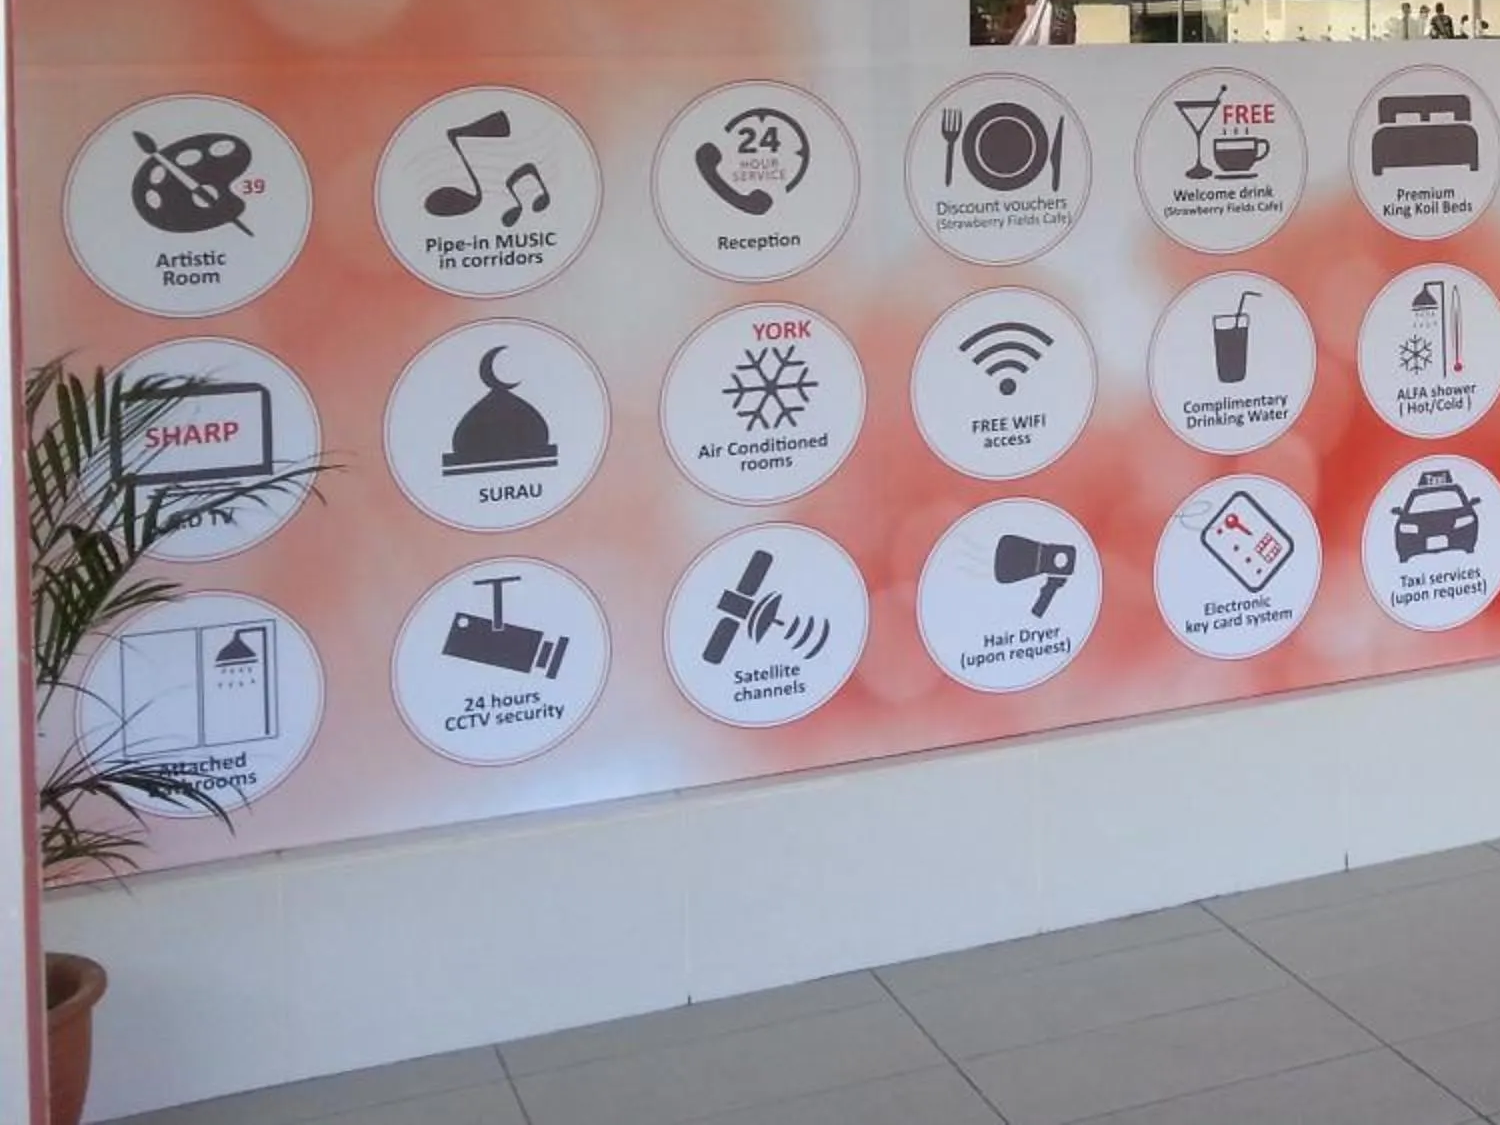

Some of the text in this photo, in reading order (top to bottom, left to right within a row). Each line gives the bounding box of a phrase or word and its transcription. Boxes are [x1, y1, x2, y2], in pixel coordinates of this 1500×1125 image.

[1222, 104, 1275, 124] FREE
[738, 126, 781, 153] 24
[740, 158, 779, 170] HOUR
[732, 169, 786, 182] SERVICE
[242, 178, 266, 195] 39
[1173, 185, 1273, 202] Welcome drink
[1397, 187, 1455, 201] Premium
[937, 195, 1068, 216] Discount vouchers
[1227, 201, 1255, 214] Fields
[1383, 198, 1473, 219] King Koil Beds
[1007, 214, 1041, 226] Fields
[426, 232, 557, 255] Pipe-in MUSIC
[718, 232, 801, 251] Reception
[156, 250, 227, 269] Artistic
[439, 248, 544, 268] in corridors
[163, 268, 221, 286] Room
[752, 320, 812, 342] YORK
[1397, 384, 1477, 400] ALFA shower
[1183, 394, 1288, 414] Complimentary
[972, 414, 1047, 434] FREE WIFI
[1186, 409, 1288, 429] Drinking Water
[144, 420, 240, 449] SHARP
[983, 433, 1032, 449] access
[697, 433, 829, 459] Air Conditioned
[740, 455, 793, 471] rooms
[478, 482, 543, 503] SURAU
[1400, 567, 1481, 588] Taxi services
[1391, 579, 1487, 607] (upon request)
[1203, 595, 1271, 616] Electronic
[1185, 609, 1292, 634] key card system
[983, 627, 1061, 648] Hair Dryer
[960, 637, 1072, 670] (upon request)
[733, 664, 801, 684] Satellite
[733, 680, 806, 702] channels
[464, 692, 541, 712] 24 hours
[445, 703, 565, 731] CCTV security
